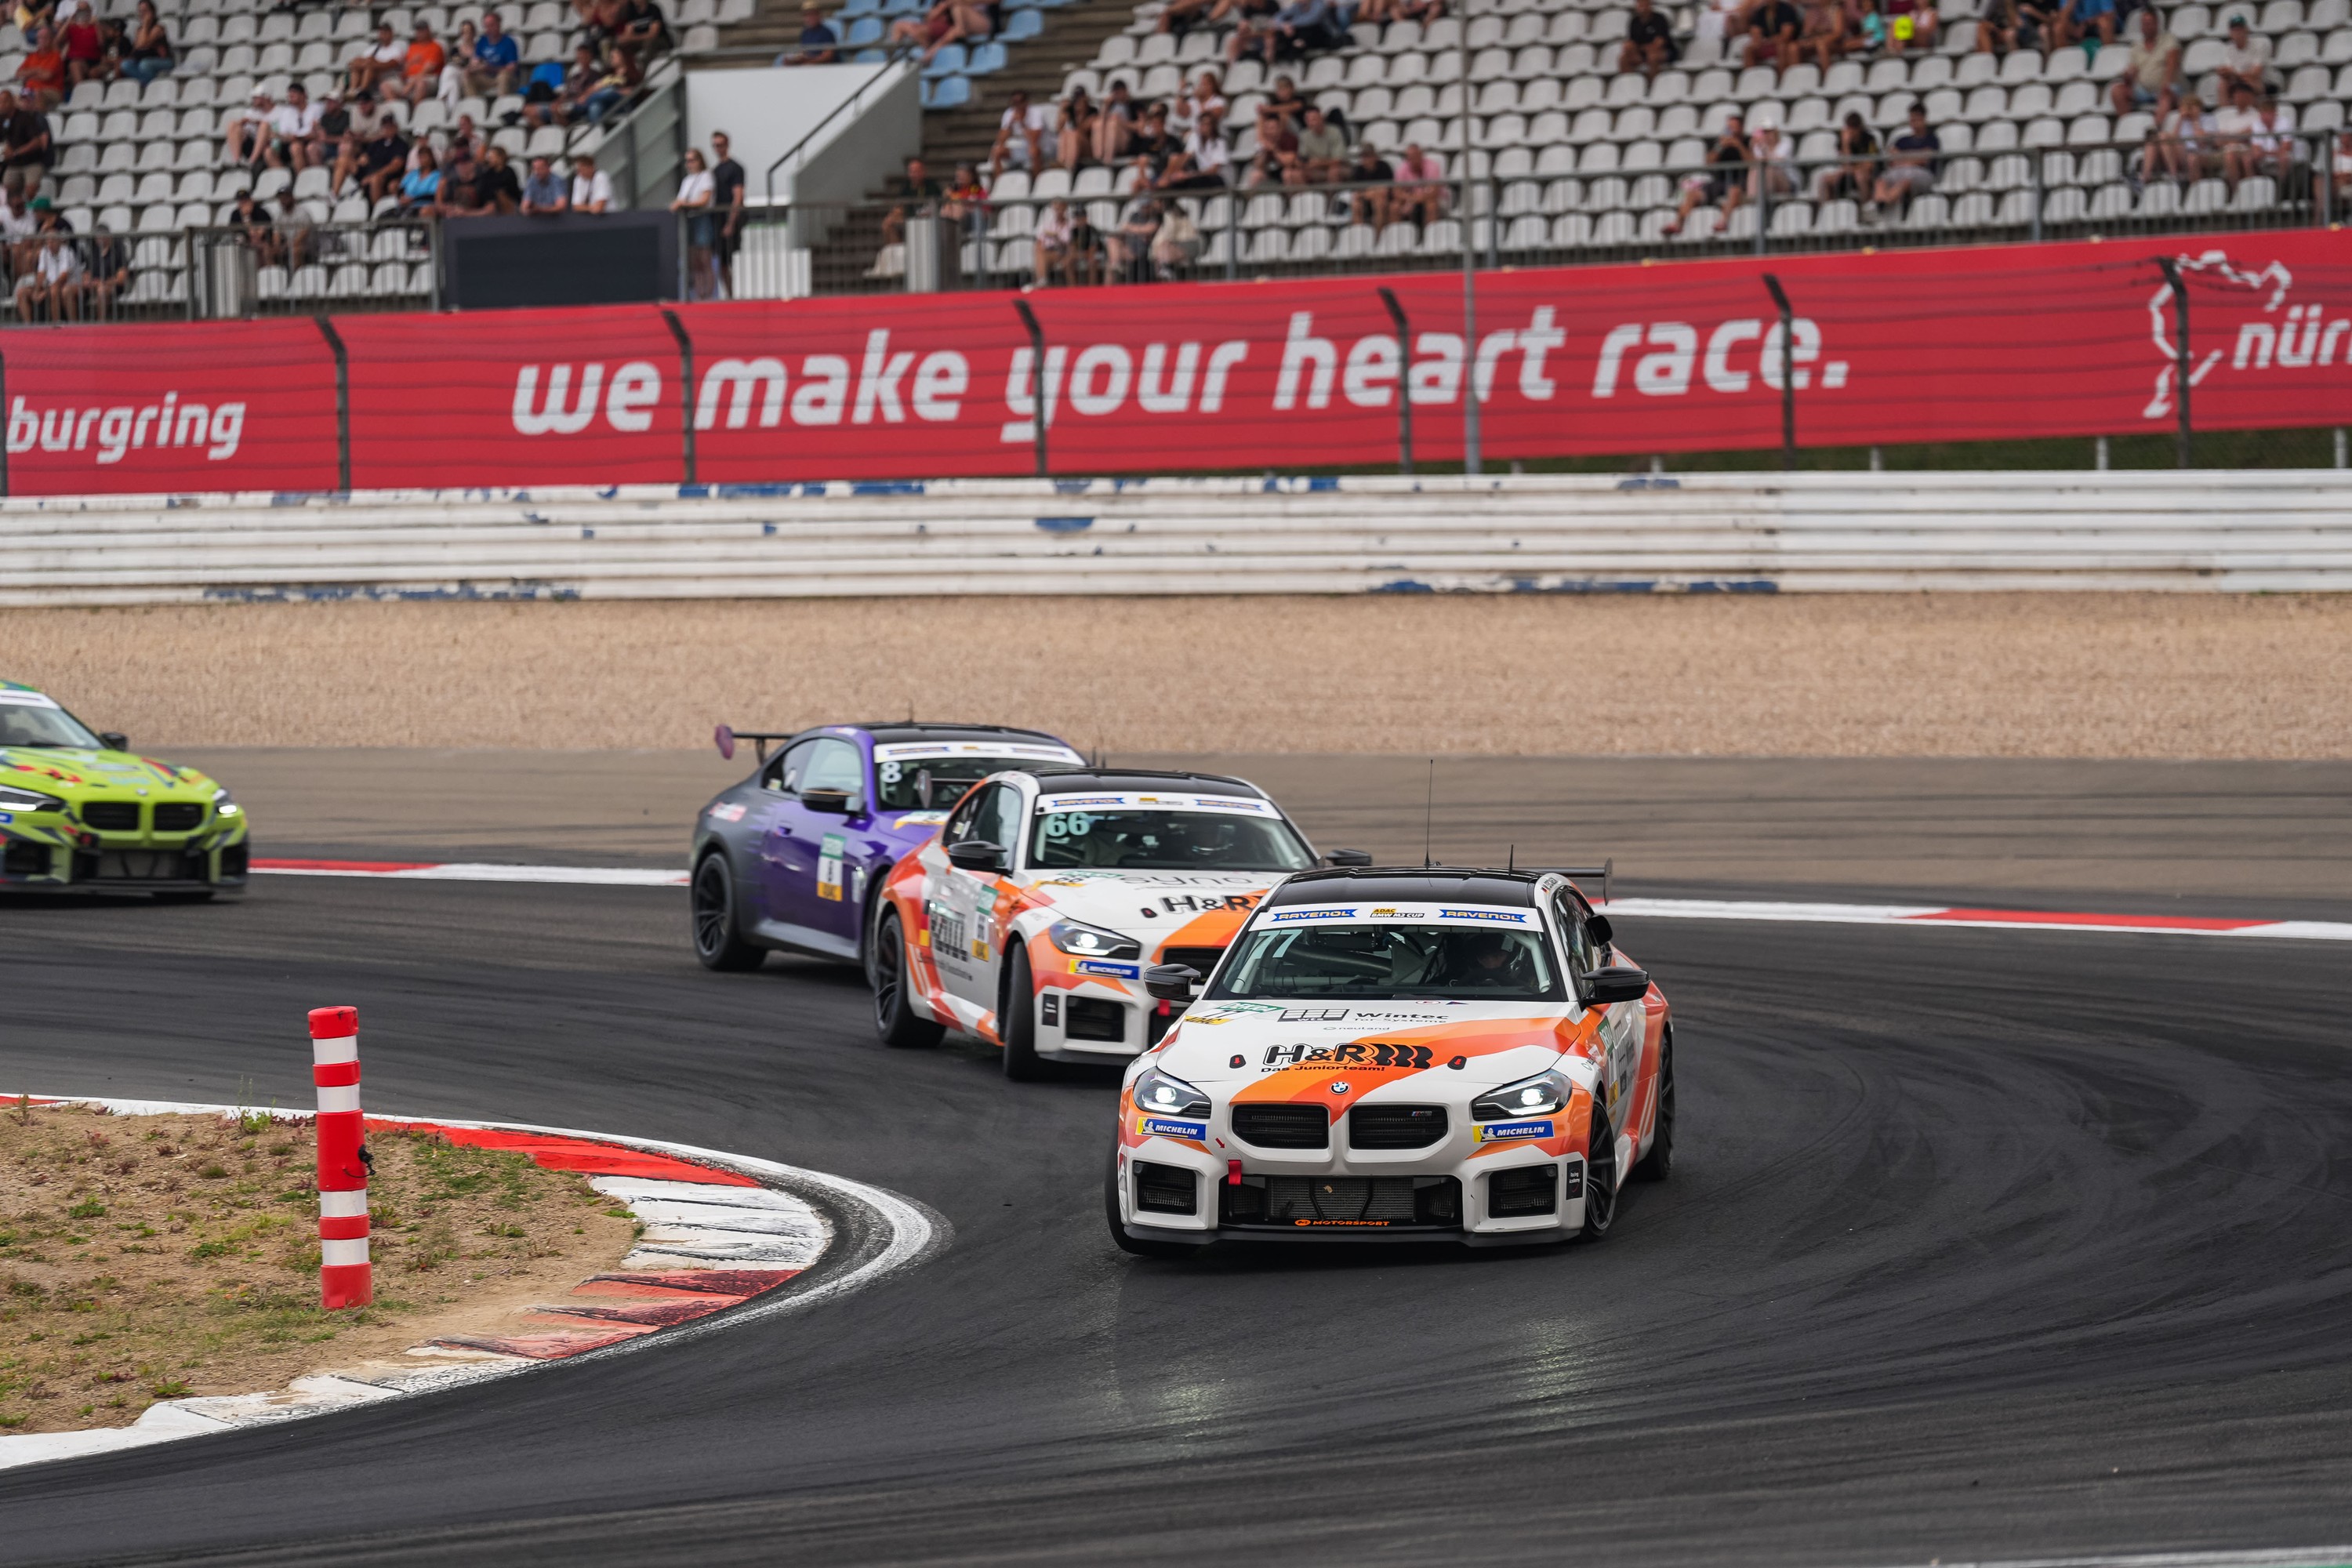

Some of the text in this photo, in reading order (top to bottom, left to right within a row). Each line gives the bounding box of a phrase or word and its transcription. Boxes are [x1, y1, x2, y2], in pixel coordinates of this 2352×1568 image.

[2232, 304, 2352, 369] nür
[513, 306, 1849, 443] we make your heart race.
[6, 391, 245, 464] burgring
[880, 762, 902, 783] 8
[1046, 812, 1090, 837] 66
[1160, 895, 1254, 914] H&R
[1279, 910, 1351, 920] RAVENOL
[1446, 911, 1519, 921] RAVENOL
[1254, 929, 1303, 960] 77
[1263, 1044, 1368, 1066] H&R
[1155, 1124, 1198, 1135] MICHELIN
[1497, 1126, 1545, 1136] MICHELIN
